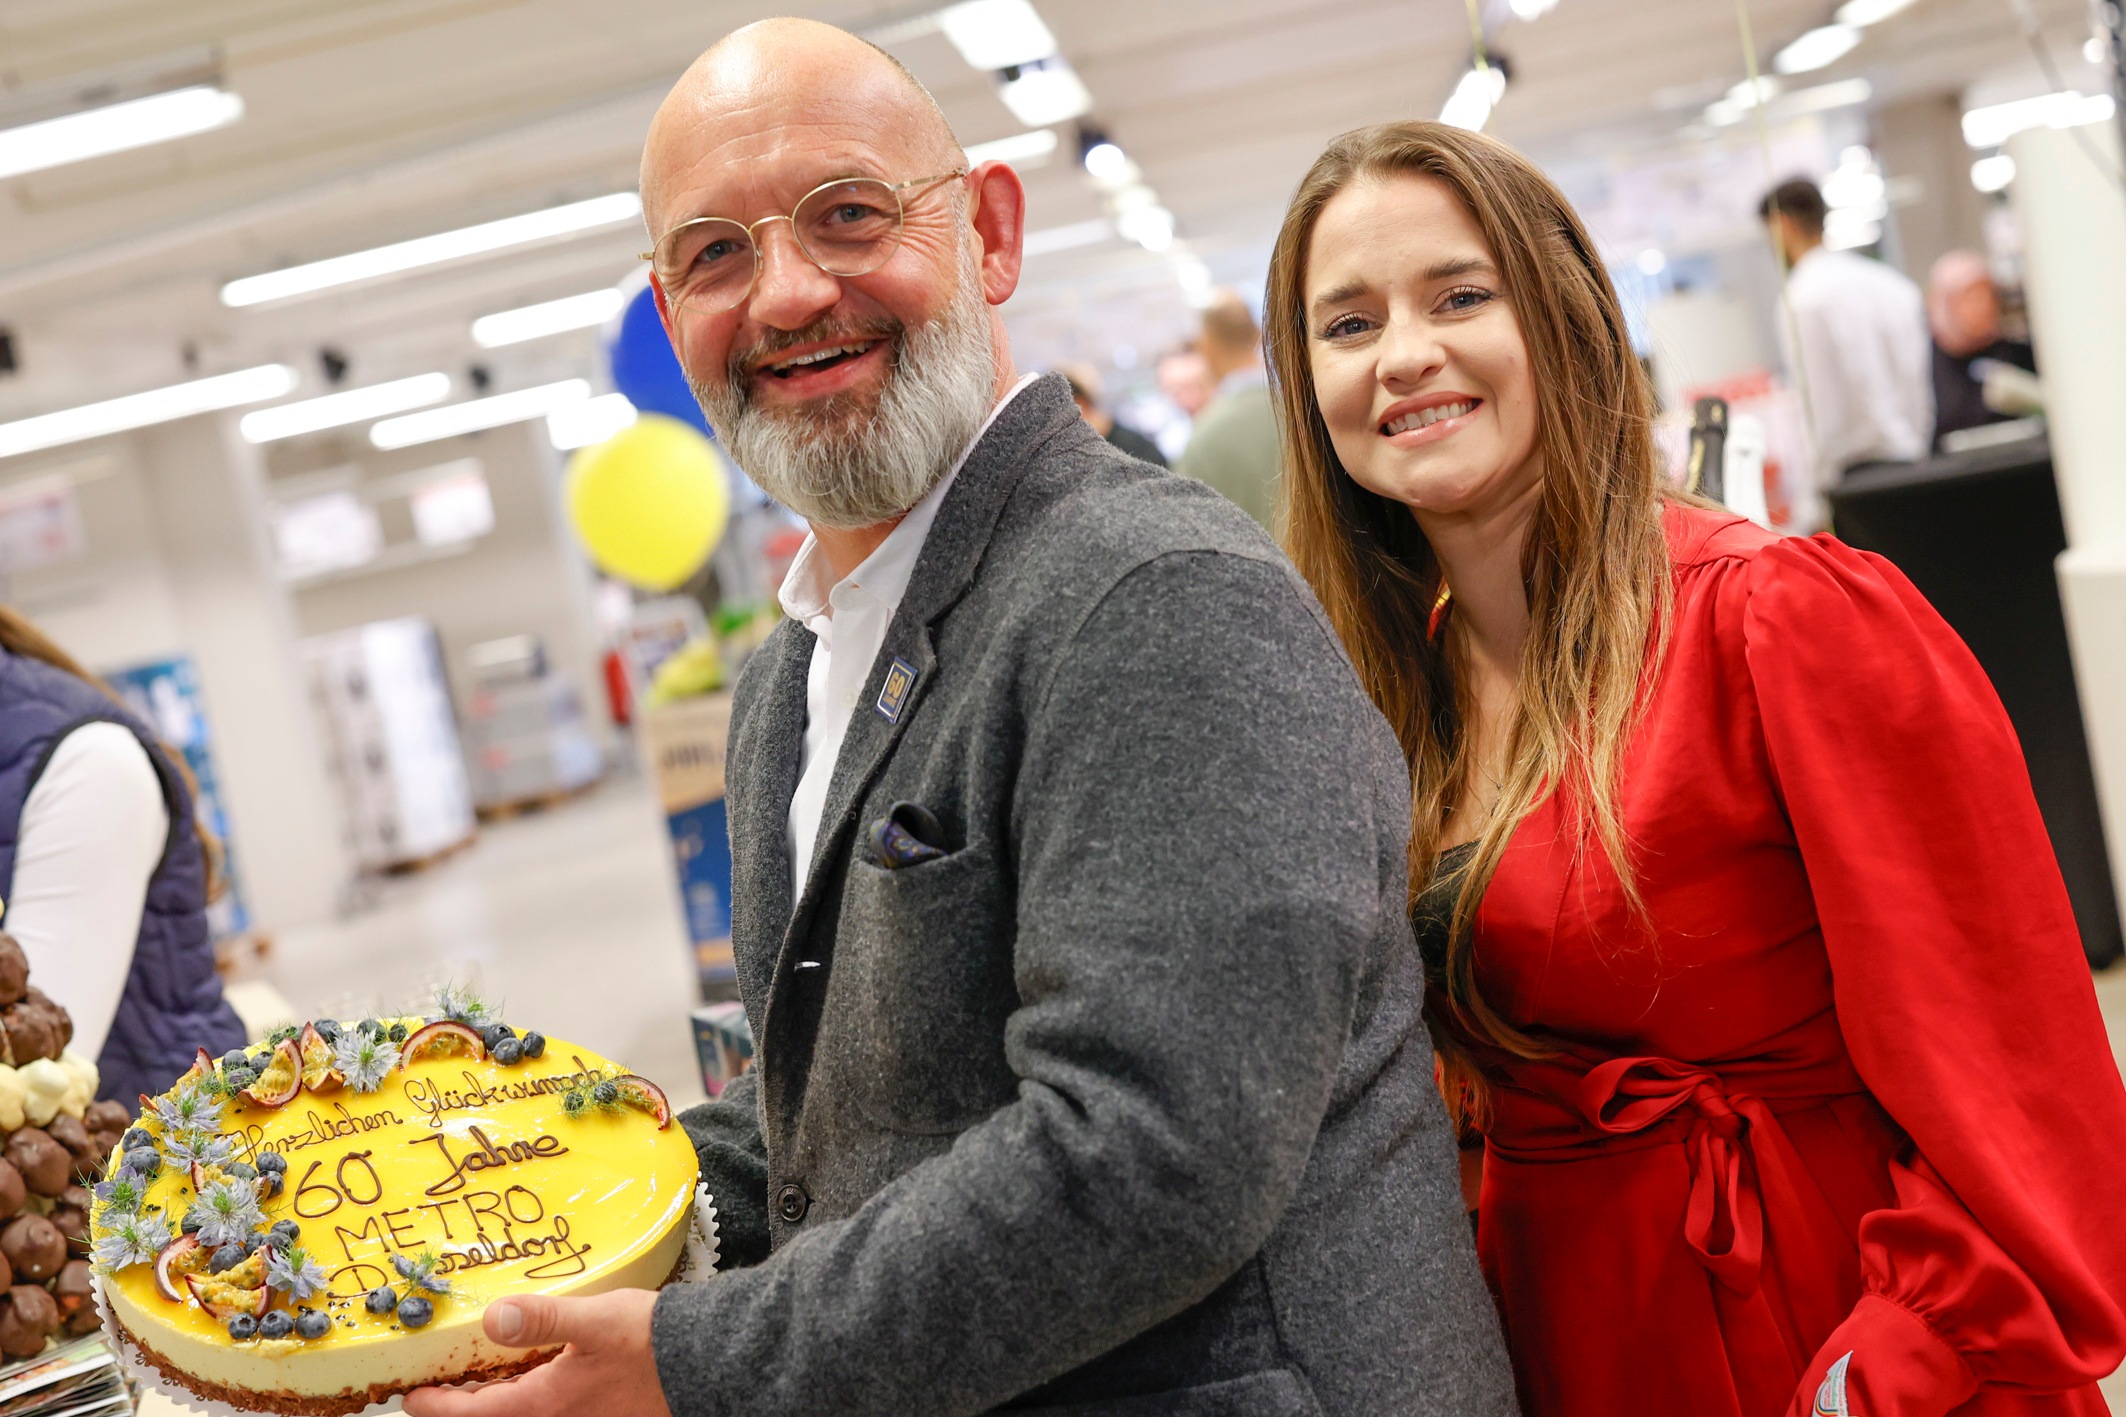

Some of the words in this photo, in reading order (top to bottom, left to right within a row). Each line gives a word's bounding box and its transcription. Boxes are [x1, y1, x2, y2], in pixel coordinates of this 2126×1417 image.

[887, 671, 906, 699] 60
[224, 1101, 404, 1165] Herzlichen
[293, 1149, 383, 1219] 60
[408, 1124, 570, 1196] Jahre
[326, 1214, 592, 1299] Dsseldorf
[334, 1184, 544, 1262] METRO
